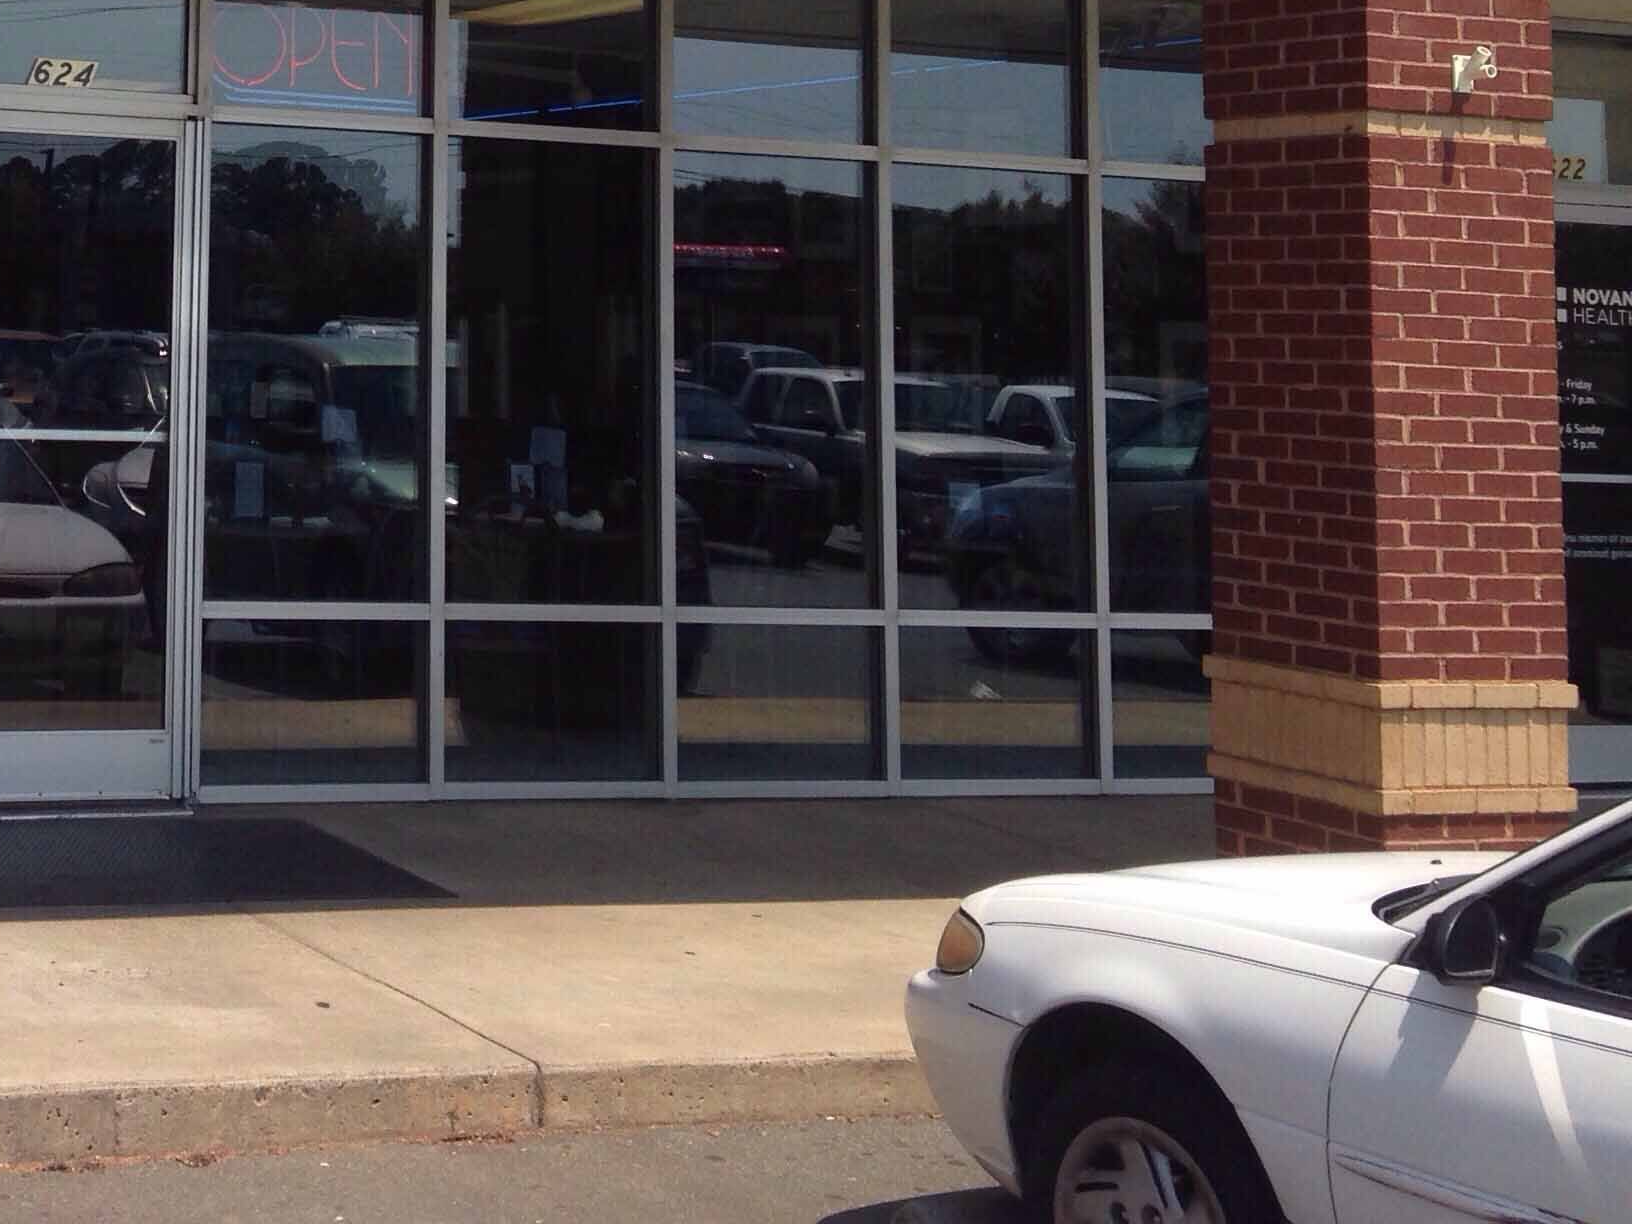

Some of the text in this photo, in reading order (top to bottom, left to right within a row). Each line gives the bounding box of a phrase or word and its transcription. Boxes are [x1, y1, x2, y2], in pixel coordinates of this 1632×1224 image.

[210, 0, 414, 96] OPEN
[33, 59, 95, 87] 624
[1566, 378, 1593, 392] Friday
[1574, 424, 1605, 438] Sunday
